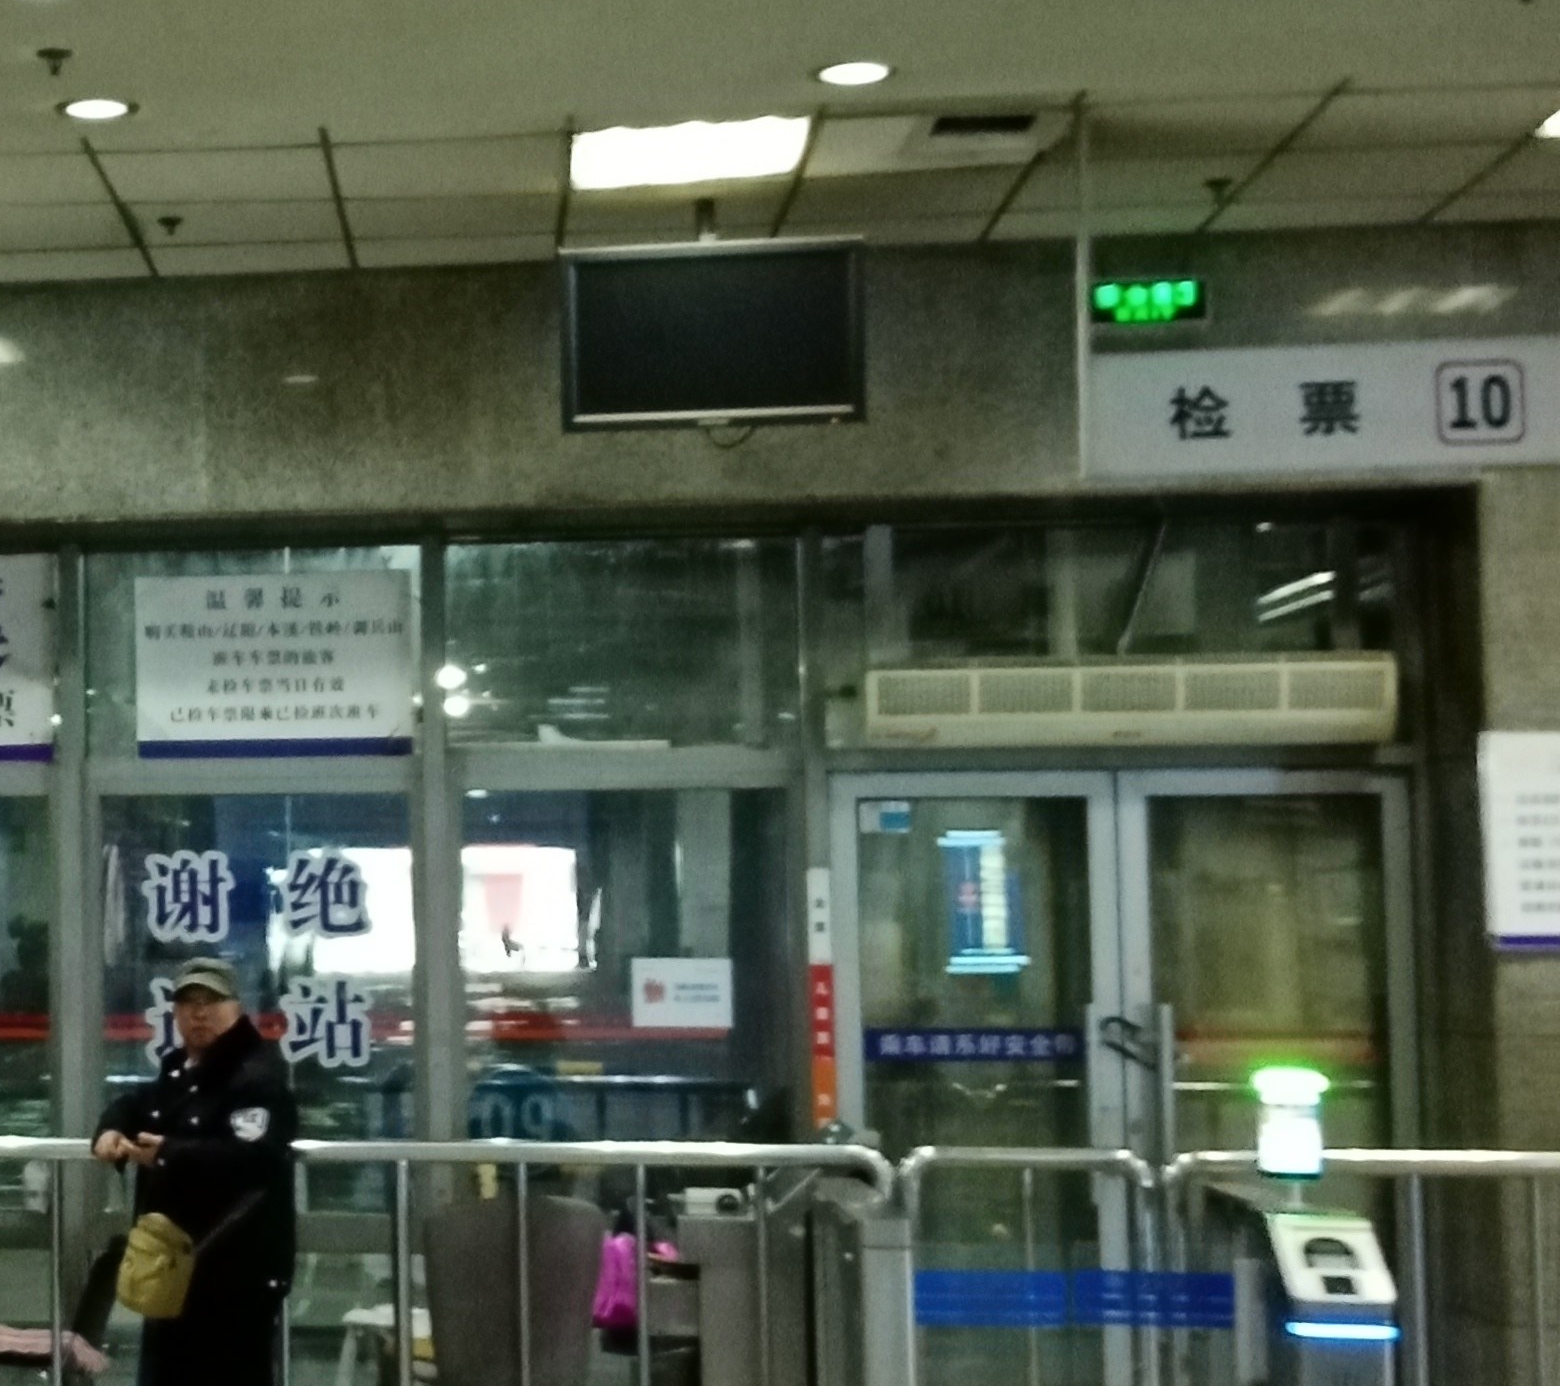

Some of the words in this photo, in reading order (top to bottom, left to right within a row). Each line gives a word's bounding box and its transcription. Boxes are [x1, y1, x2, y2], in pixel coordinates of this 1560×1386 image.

[1169, 381, 1359, 441] 检票
[1449, 374, 1512, 430] 10
[205, 586, 341, 611] 温馨提示
[205, 675, 346, 695] 未检车票当日有效
[149, 856, 368, 936] 谢绝
